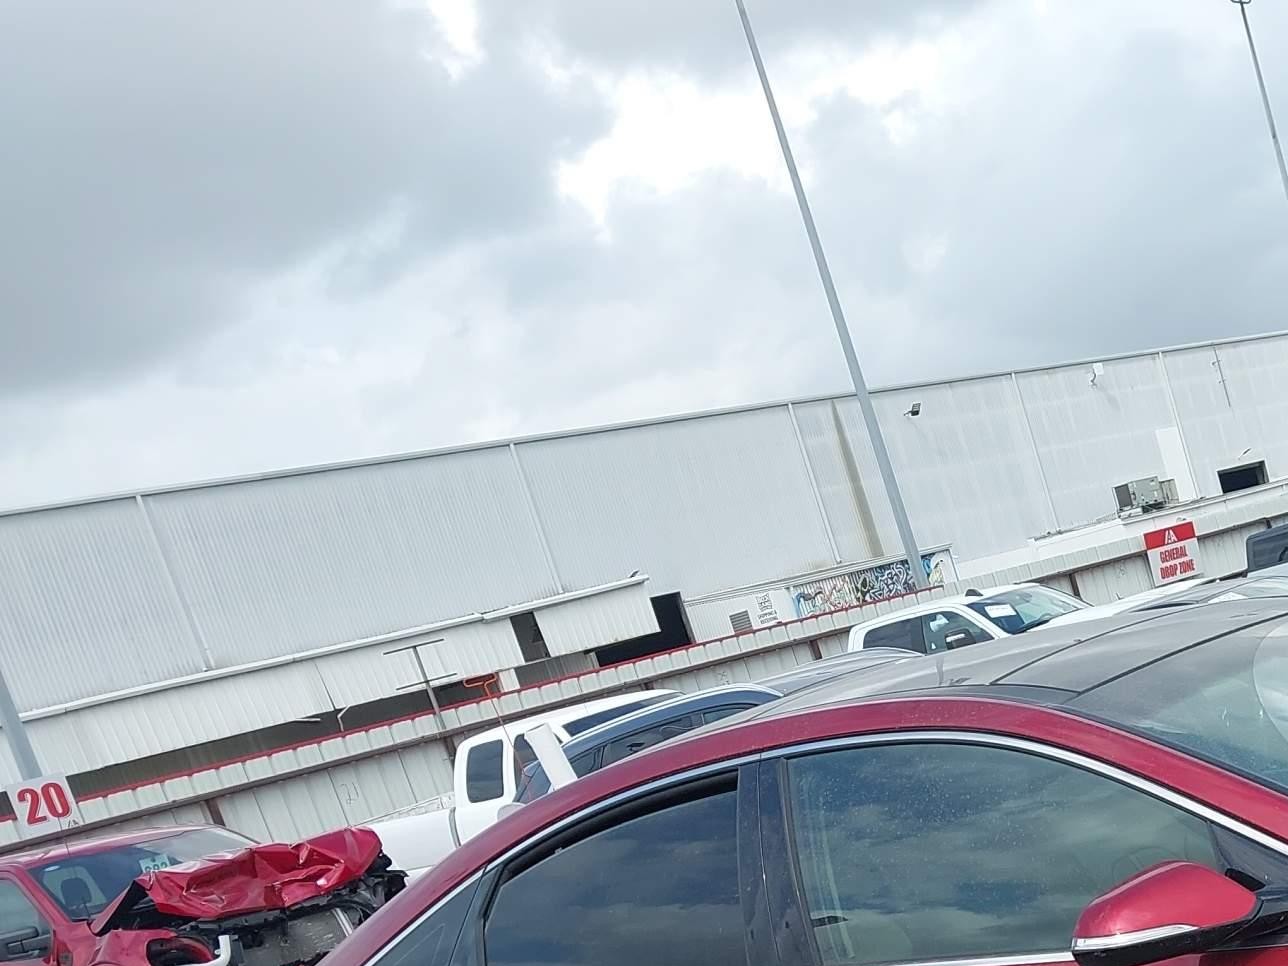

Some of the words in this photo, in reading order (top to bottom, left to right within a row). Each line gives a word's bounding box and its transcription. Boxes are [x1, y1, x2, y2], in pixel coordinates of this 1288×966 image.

[1160, 545, 1188, 563] GENERAL
[1160, 563, 1178, 579] DROP
[1179, 559, 1195, 575] ZONE
[17, 782, 70, 825] 20
